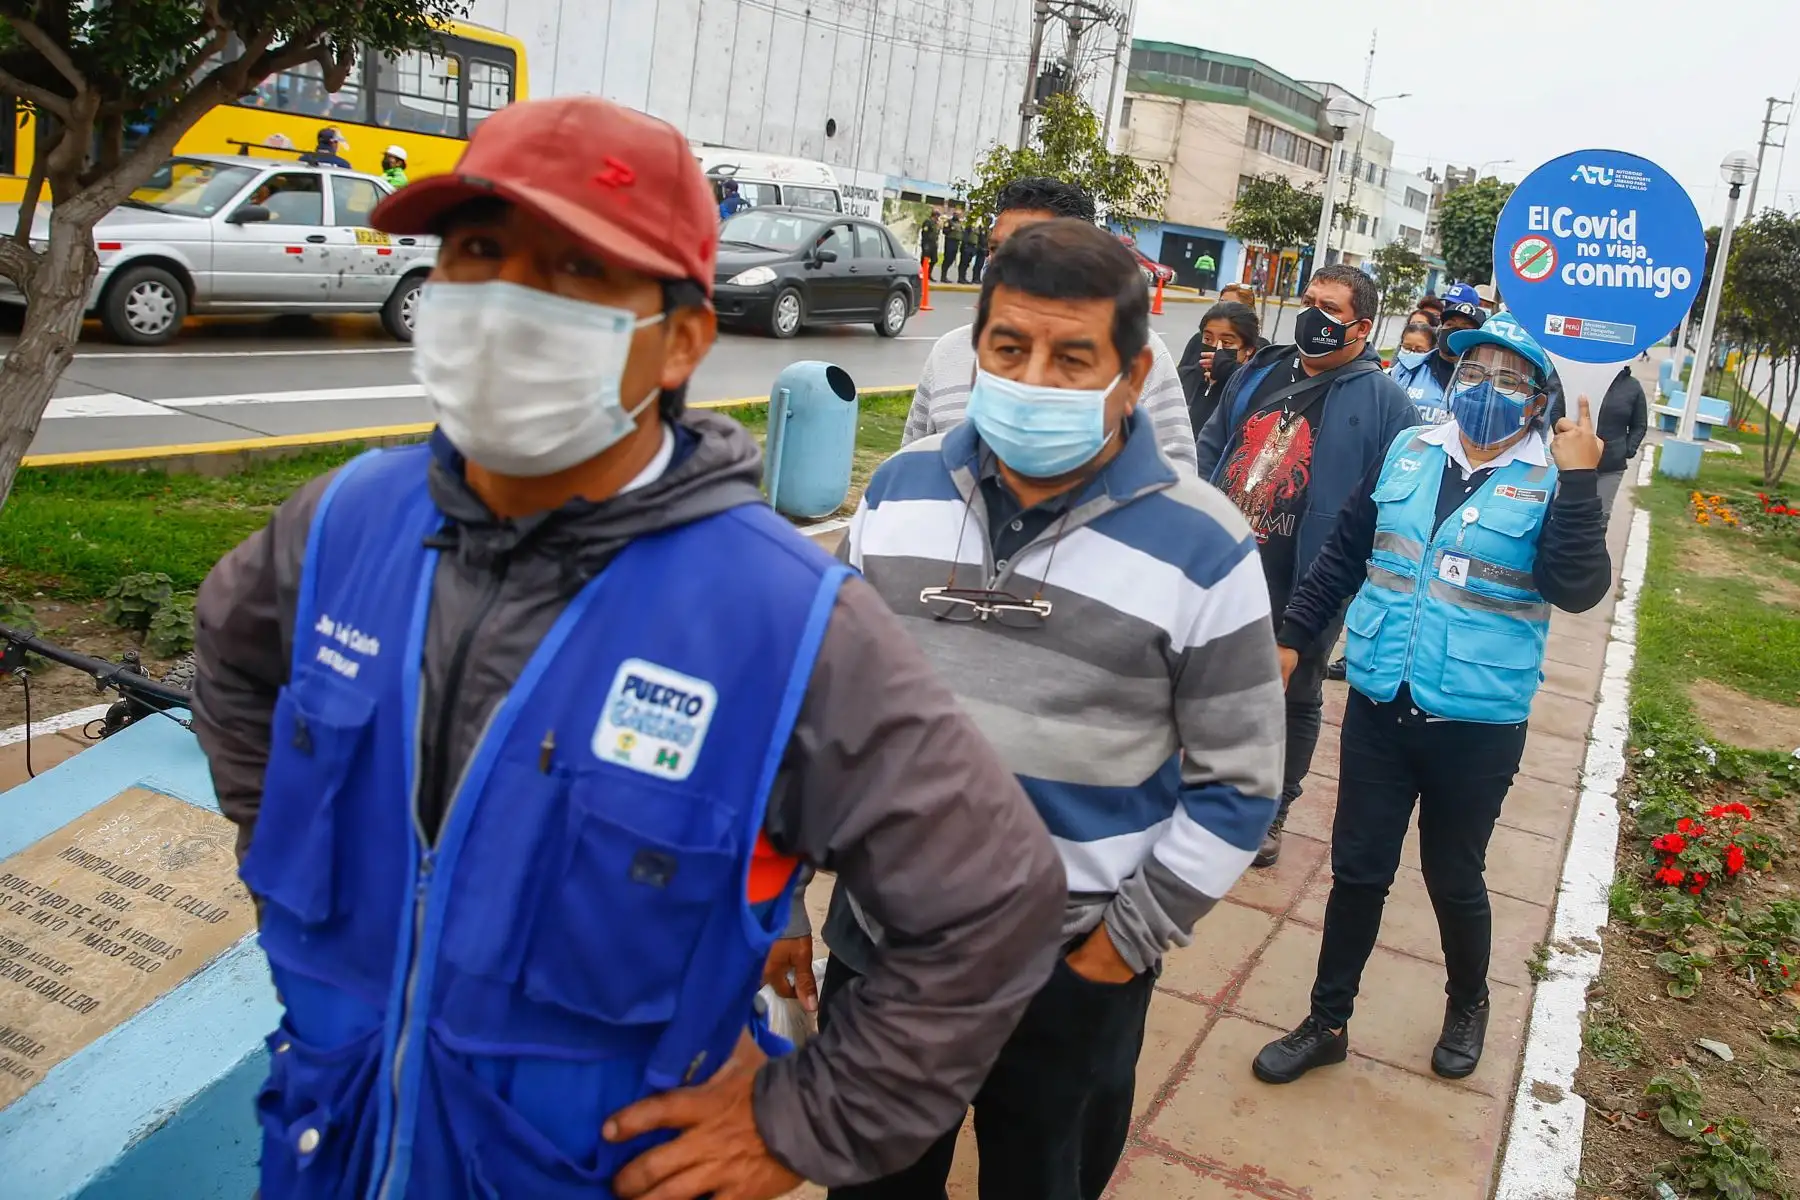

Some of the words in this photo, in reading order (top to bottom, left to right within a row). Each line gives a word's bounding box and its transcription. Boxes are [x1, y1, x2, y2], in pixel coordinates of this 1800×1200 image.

[1570, 164, 1614, 186] ATU
[1528, 205, 1549, 231] El
[1552, 206, 1637, 241] Covid
[1577, 242, 1600, 257] no
[1606, 240, 1647, 264] viaja
[1561, 257, 1691, 299] conmigo
[621, 674, 704, 718] PUERTO
[57, 846, 151, 890] MUNICIPALIDAD
[146, 883, 177, 902] DEL
[174, 895, 229, 924] CALLAO
[0, 873, 70, 910] BOULEVARD
[65, 903, 92, 919] DE
[87, 913, 120, 931] LAS
[117, 927, 183, 960] AVENIDAS
[8, 901, 33, 915] DE
[28, 909, 69, 932] MAYO
[67, 926, 85, 938] Y
[79, 932, 127, 957] MARCO
[121, 951, 162, 973] POLO
[25, 975, 100, 1015] CABALLERO
